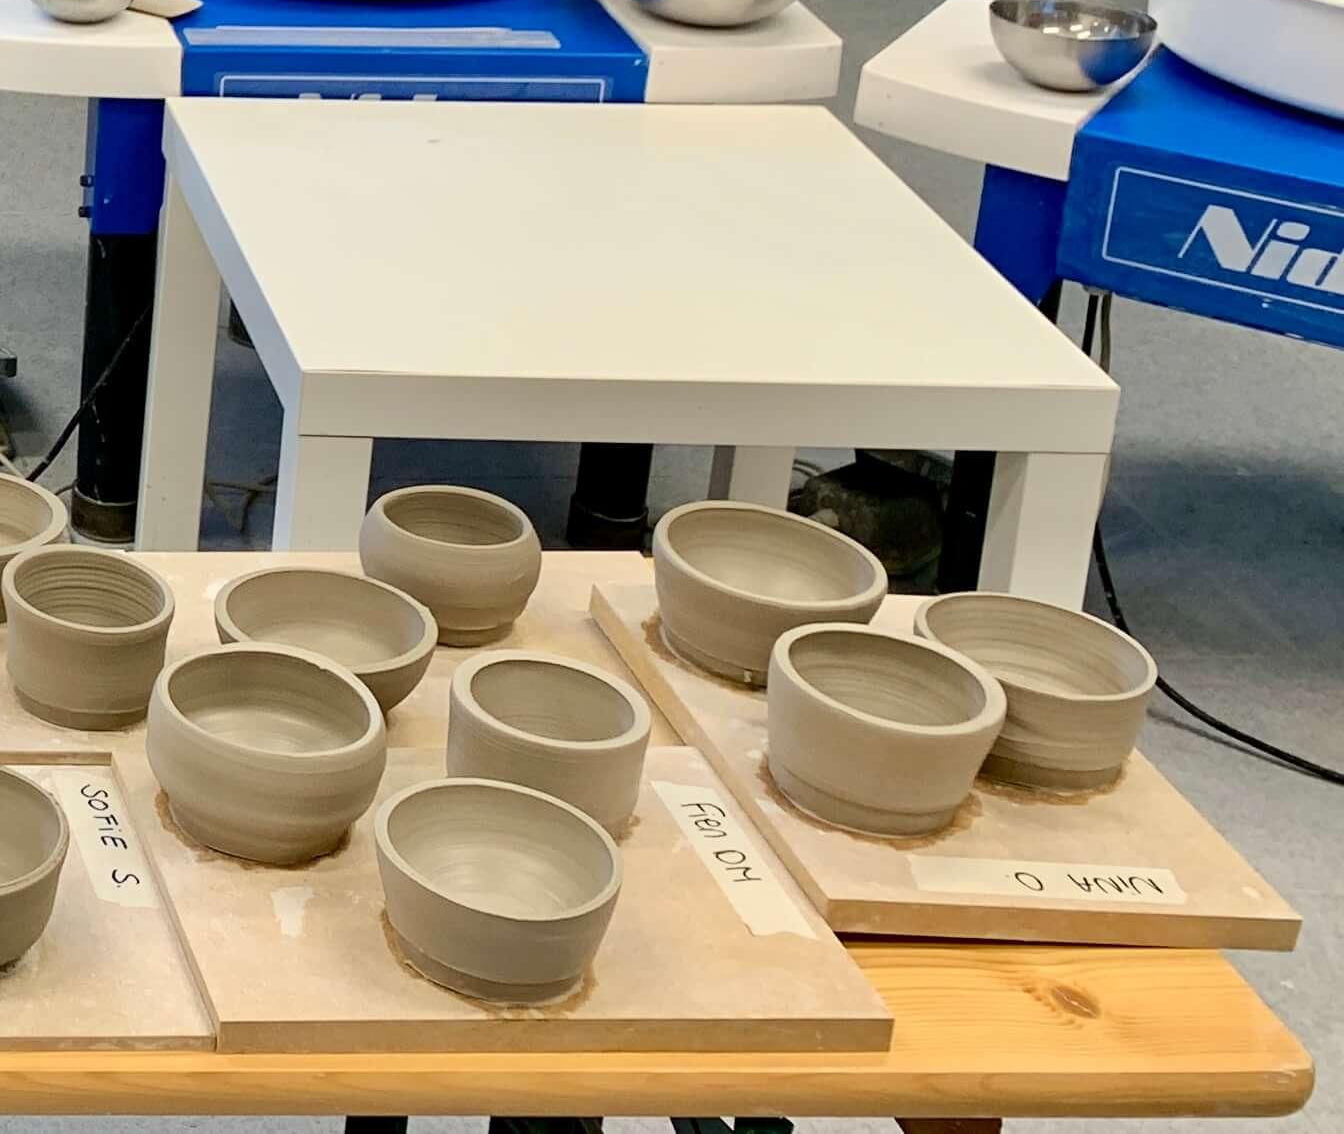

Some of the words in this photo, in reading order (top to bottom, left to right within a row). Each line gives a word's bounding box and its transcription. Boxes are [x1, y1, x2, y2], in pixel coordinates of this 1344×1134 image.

[1176, 203, 1344, 296] Nid
[111, 868, 141, 889] S.
[680, 801, 728, 839] Fien
[712, 849, 763, 883] DM
